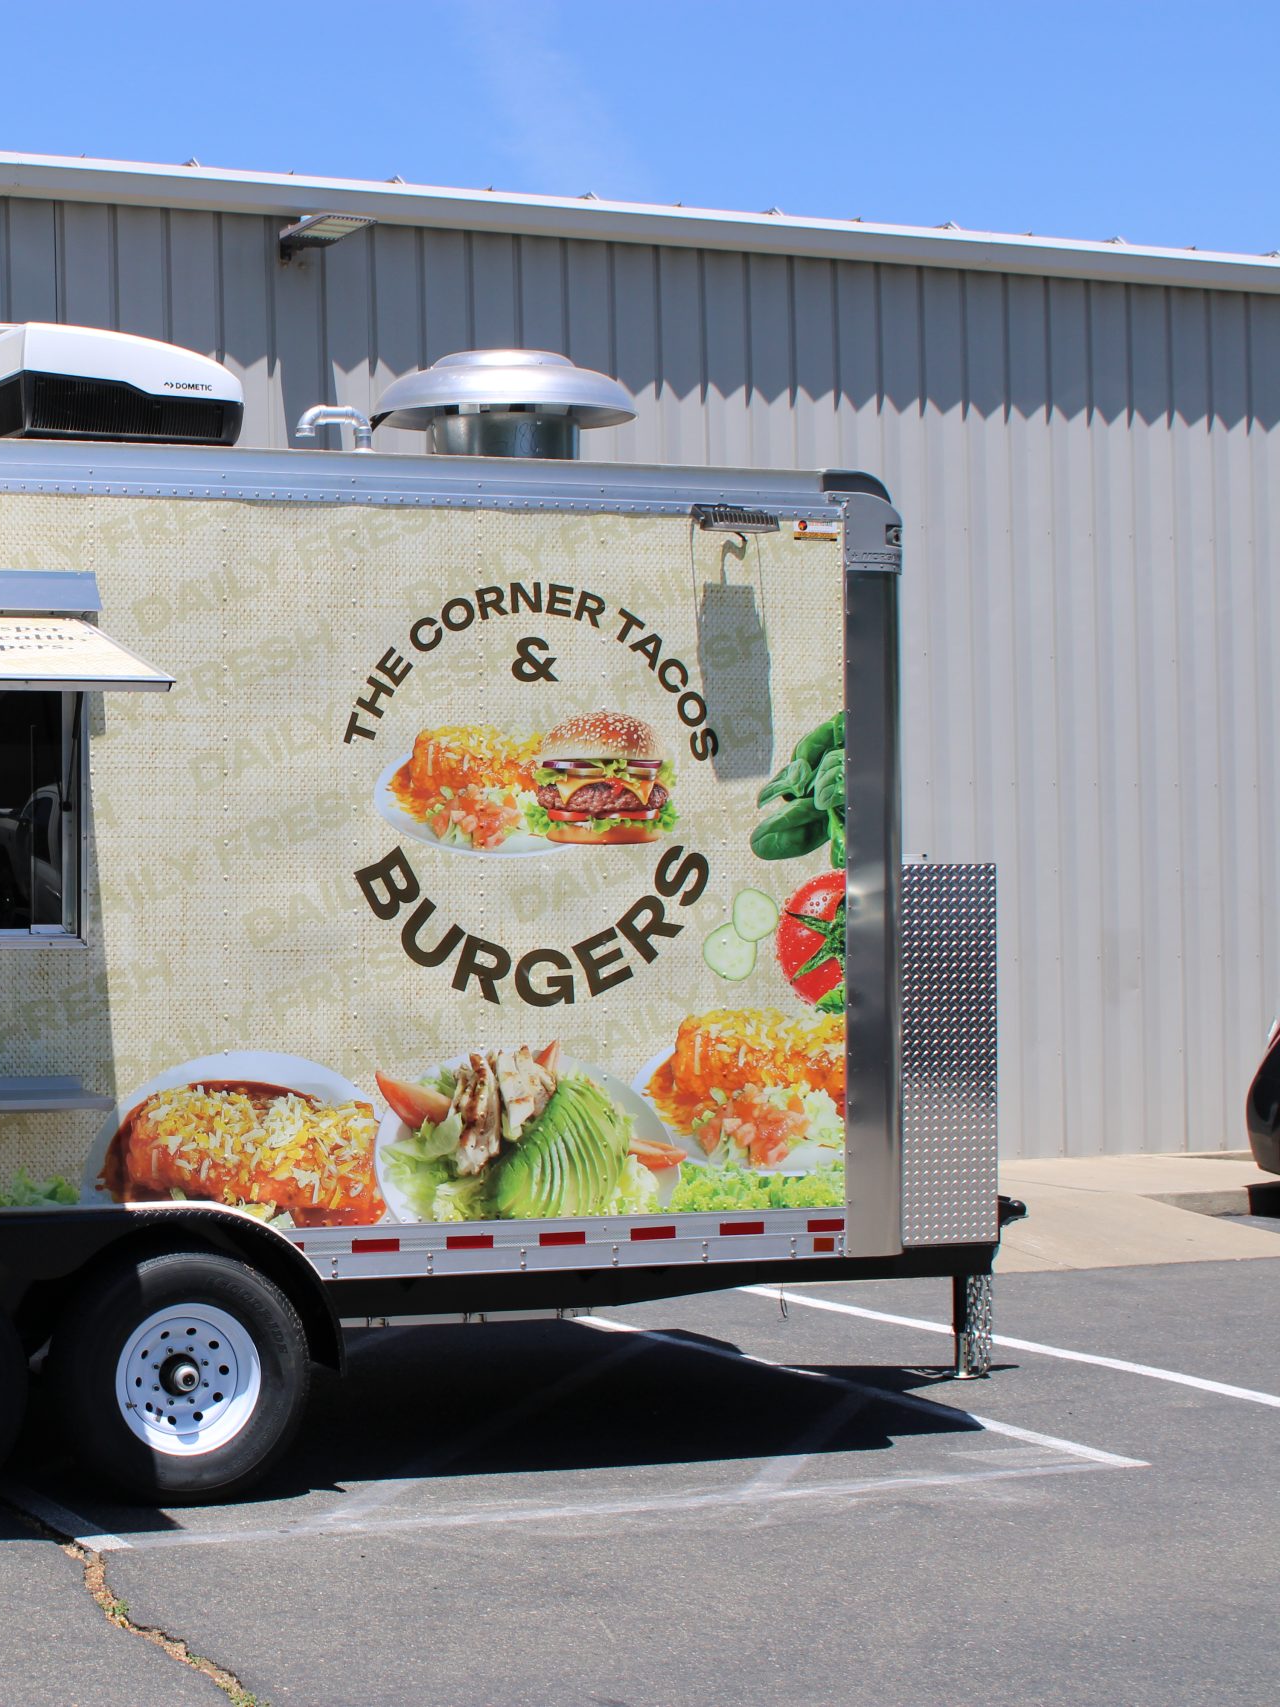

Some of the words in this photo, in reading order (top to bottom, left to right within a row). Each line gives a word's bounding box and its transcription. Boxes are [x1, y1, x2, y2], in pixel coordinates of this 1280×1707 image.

[175, 382, 213, 392] DOMETIC
[293, 508, 444, 574] FRES
[343, 646, 414, 745] THE
[409, 581, 607, 653] CORNER
[616, 608, 720, 762] TACOS
[511, 636, 559, 683] &
[241, 873, 372, 950] DAIL
[354, 845, 710, 1008] BURGERS
[267, 942, 412, 1026] FRES
